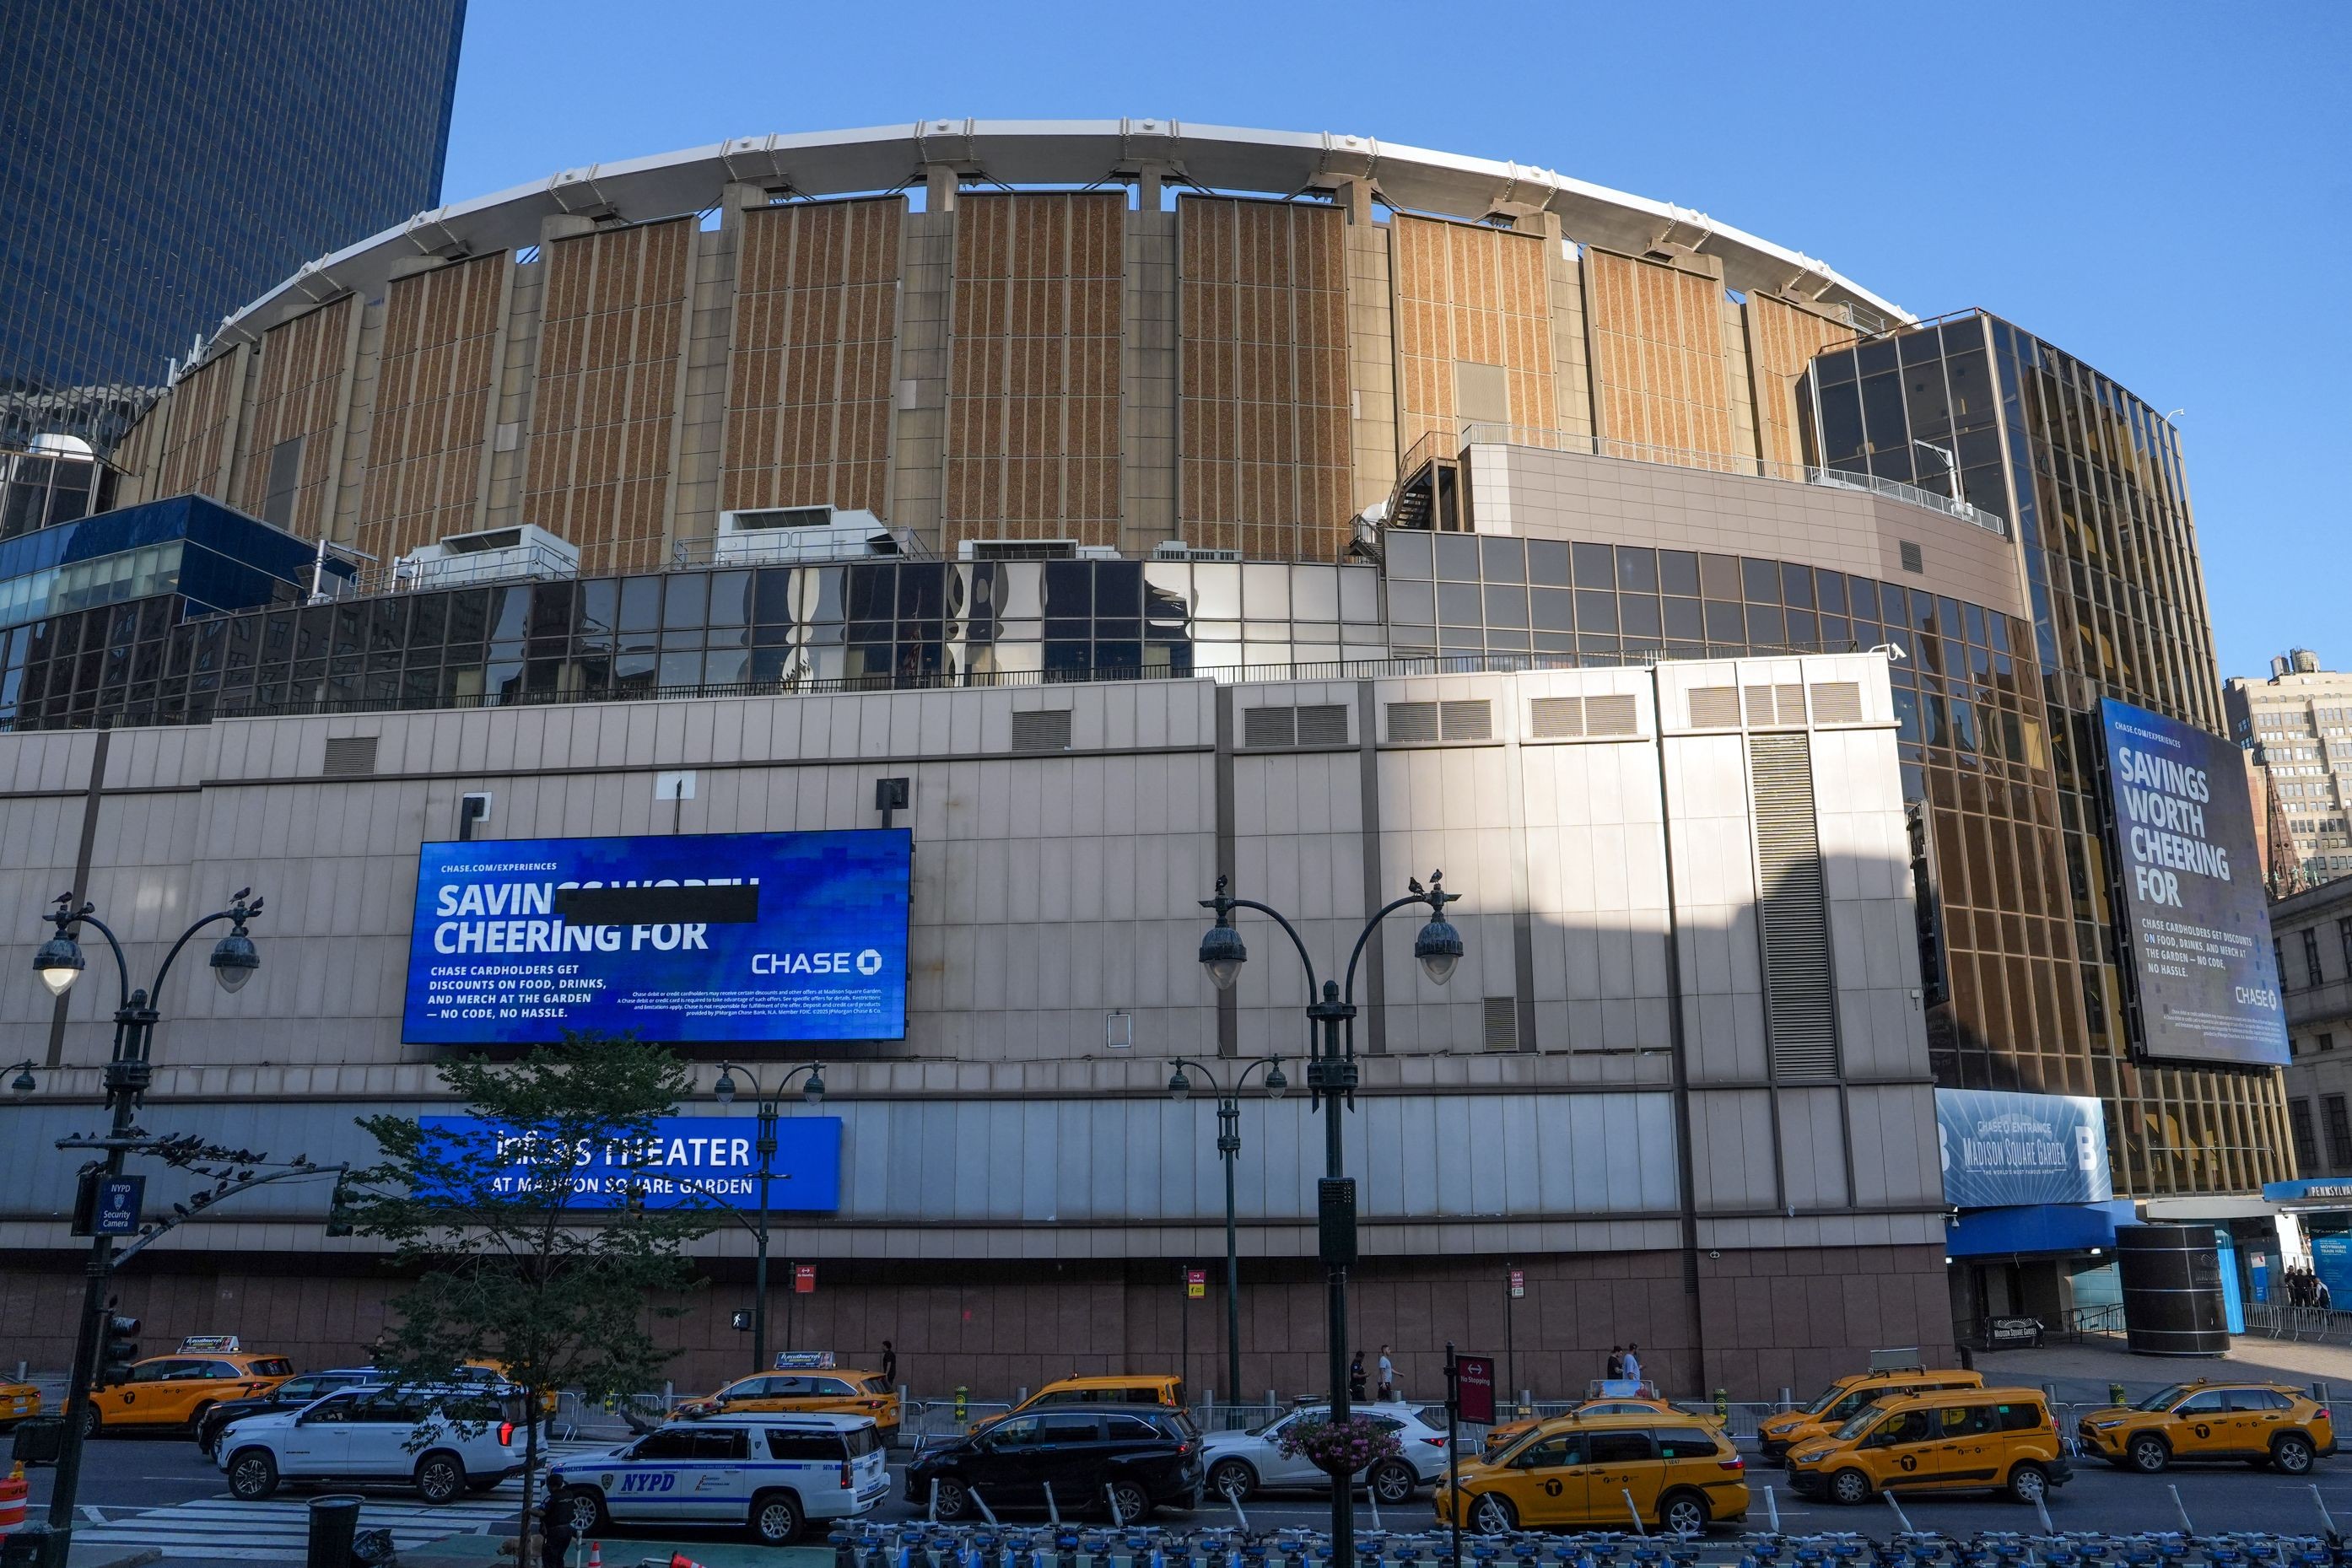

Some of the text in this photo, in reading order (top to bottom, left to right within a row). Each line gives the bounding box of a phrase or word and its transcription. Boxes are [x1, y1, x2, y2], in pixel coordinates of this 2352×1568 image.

[2115, 721, 2182, 748] CHASE.COM/EXPERIENCES
[2118, 746, 2209, 804] SAVINGS
[2123, 785, 2206, 838] WORTH
[2130, 826, 2231, 881] CHEERING
[440, 862, 558, 873] CHASE.COM/EXPERIENCES
[2134, 865, 2183, 908] FOR
[436, 881, 604, 917] SAVIN
[434, 919, 709, 954] CHEERING FOR
[2142, 919, 2252, 947] CHASE CARDHOLDERS GET DISCOUNTS
[2144, 933, 2247, 959] ON FOOD, DRINKS, AND MERCH AT
[752, 952, 851, 974] CHASE
[2145, 948, 2226, 970] THE GARDEN NO CODE,
[430, 964, 580, 976] CHASE CARDHOLDERS GET
[2148, 963, 2188, 978] NO HASSLE.
[429, 978, 607, 990] DISCOUNTS ON FOOD, DRINKS,
[428, 993, 591, 1005] AND MERCH AT THE GARDEN
[2236, 986, 2268, 1007] CHASE
[440, 1008, 568, 1020] NO CODE, NO HASSLE.
[1977, 1120, 2052, 1134] CHASE ENTRANCE
[1963, 1137, 2067, 1167] MADISON SQUARE GARDEN
[2075, 1126, 2097, 1171] B
[111, 1184, 131, 1193] NYPD
[491, 1177, 513, 1192] AT
[605, 1178, 674, 1194] SQARE
[680, 1179, 753, 1194] GARDEN
[2311, 1186, 2352, 1196] PENNSYLVA
[103, 1210, 131, 1220] Security
[1468, 1377, 1491, 1386] Stopping
[620, 1474, 676, 1491] NYPD
